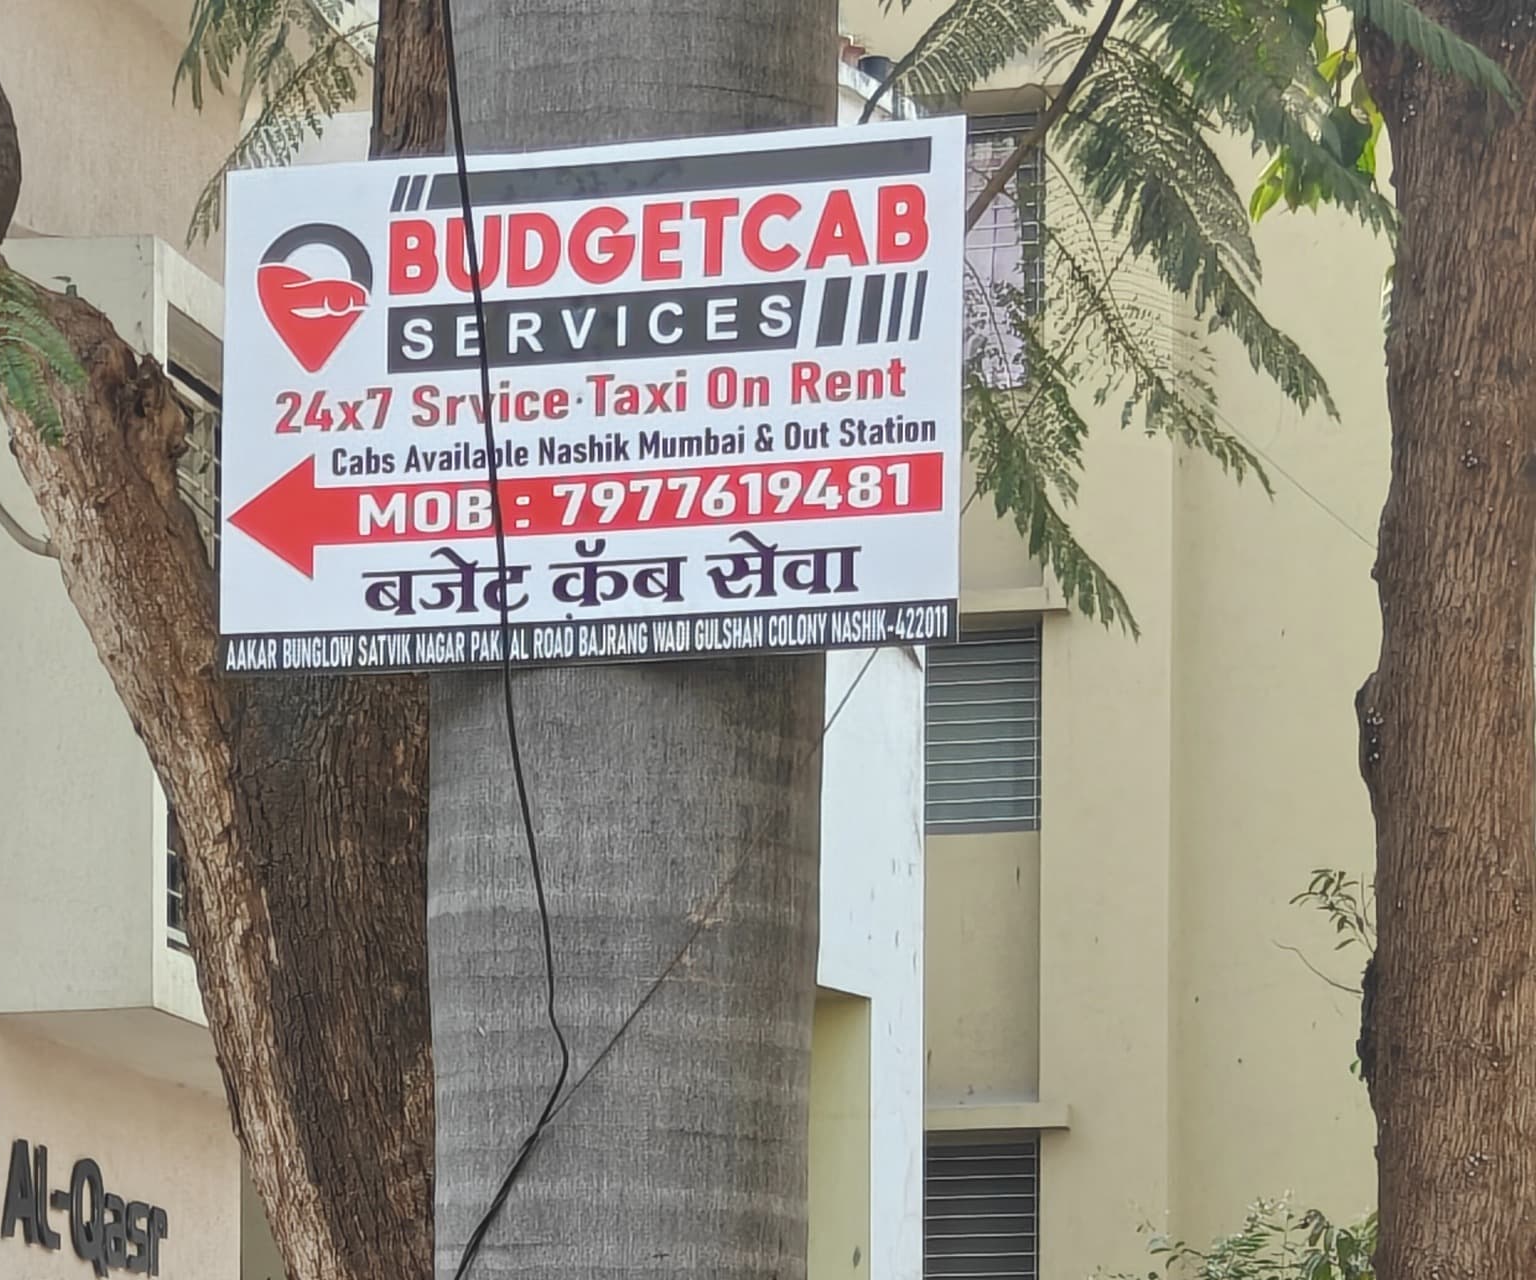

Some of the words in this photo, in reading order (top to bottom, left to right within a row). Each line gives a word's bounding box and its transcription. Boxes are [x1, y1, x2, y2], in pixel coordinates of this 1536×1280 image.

[388, 184, 929, 296] BUDGETCAB
[401, 294, 794, 361] SERVICES
[275, 387, 393, 434] 24x7
[412, 380, 569, 428] Srvice
[586, 369, 687, 416] Taxi
[707, 366, 770, 410] On
[791, 357, 906, 405] Rent
[332, 446, 395, 476] Cabs
[538, 433, 630, 468] Nashik
[639, 425, 745, 461] Mumbai
[754, 423, 774, 452] &
[784, 421, 830, 450] Out
[839, 415, 936, 447] Station
[552, 463, 910, 527] 7977619481
[362, 546, 532, 616] बजेट
[705, 530, 863, 600] सेवा
[225, 637, 277, 672] AAKAR
[282, 634, 354, 669] BUNGLOW
[357, 633, 412, 668] SATVIK
[415, 631, 465, 666] NAGAR
[534, 625, 573, 660] ROAD
[579, 620, 649, 657] BAJRANG
[653, 620, 691, 653] WADI
[695, 615, 763, 651] GULSHAN
[768, 611, 828, 648] COLONY
[831, 604, 949, 645] NASHIK-422011
